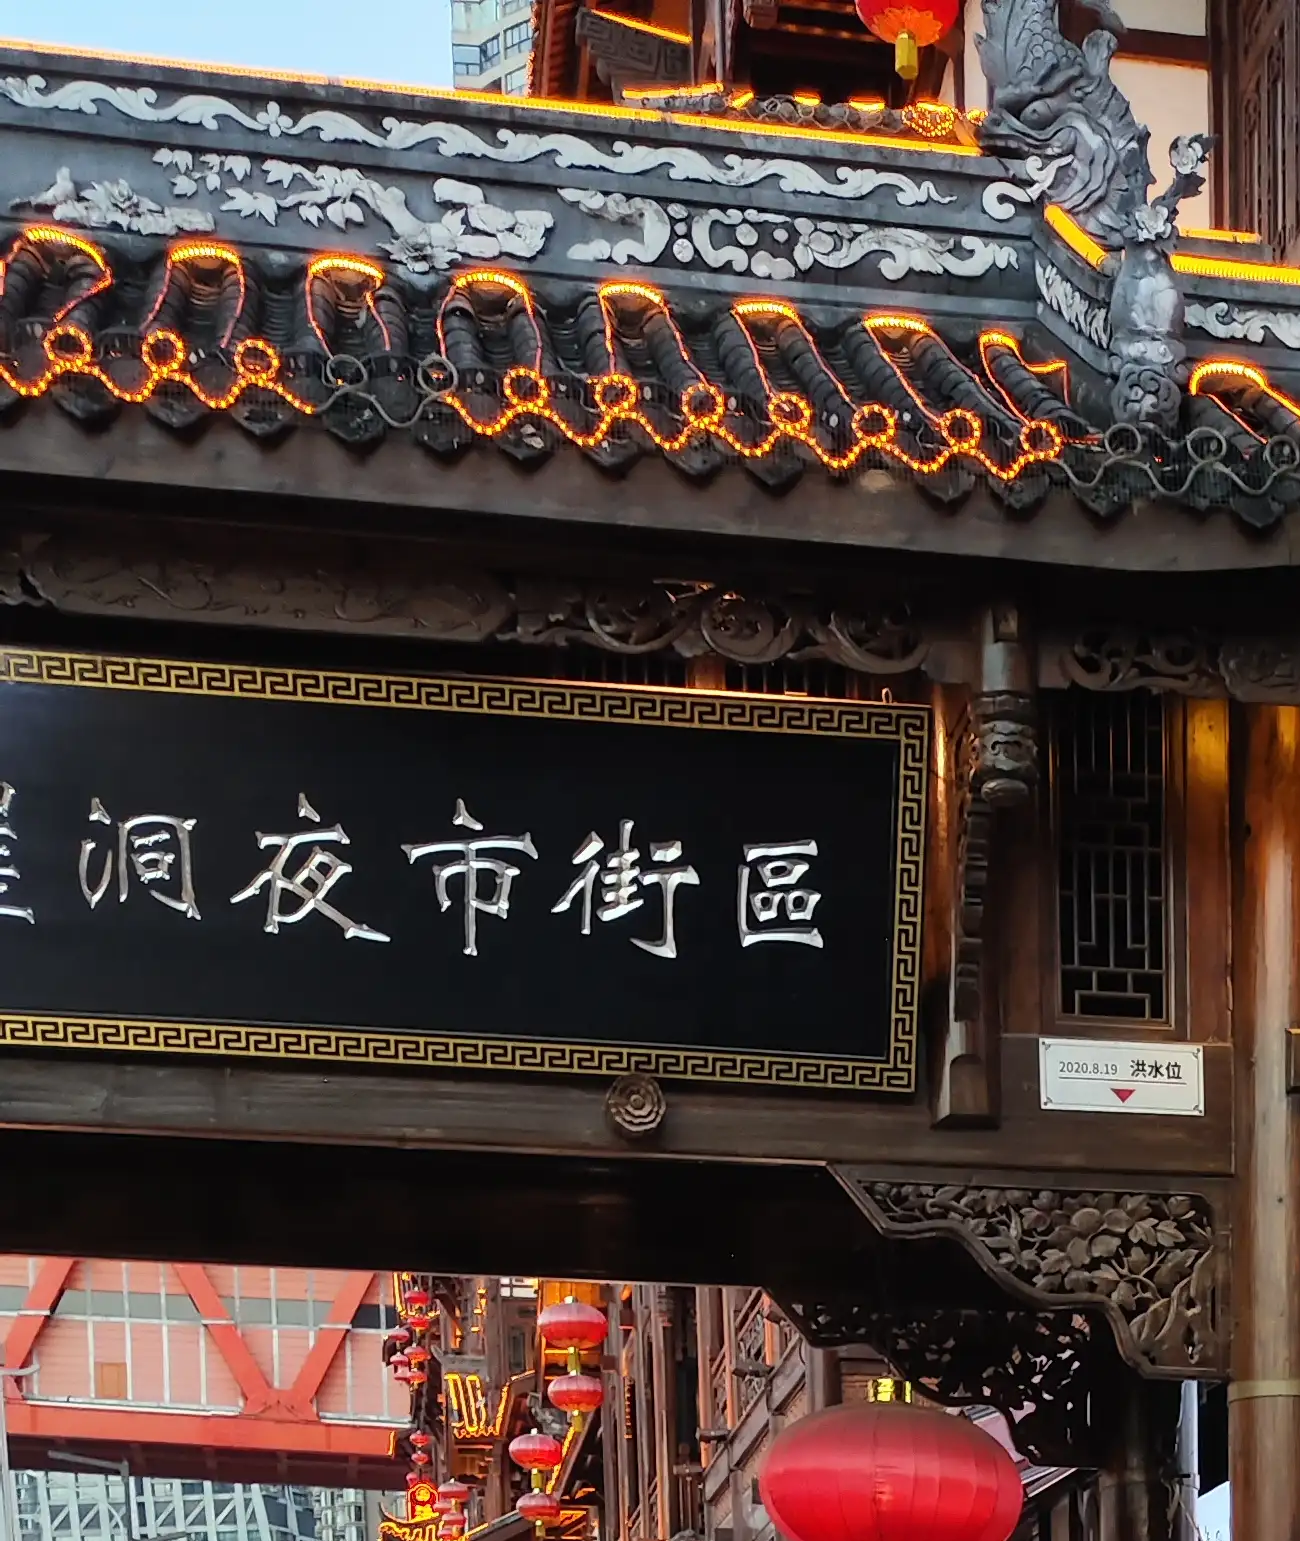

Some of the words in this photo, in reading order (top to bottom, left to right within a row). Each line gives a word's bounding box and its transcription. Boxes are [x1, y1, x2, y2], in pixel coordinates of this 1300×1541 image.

[1058, 1060, 1118, 1076] 2020.8.19
[1129, 1059, 1183, 1080] 洪水位
